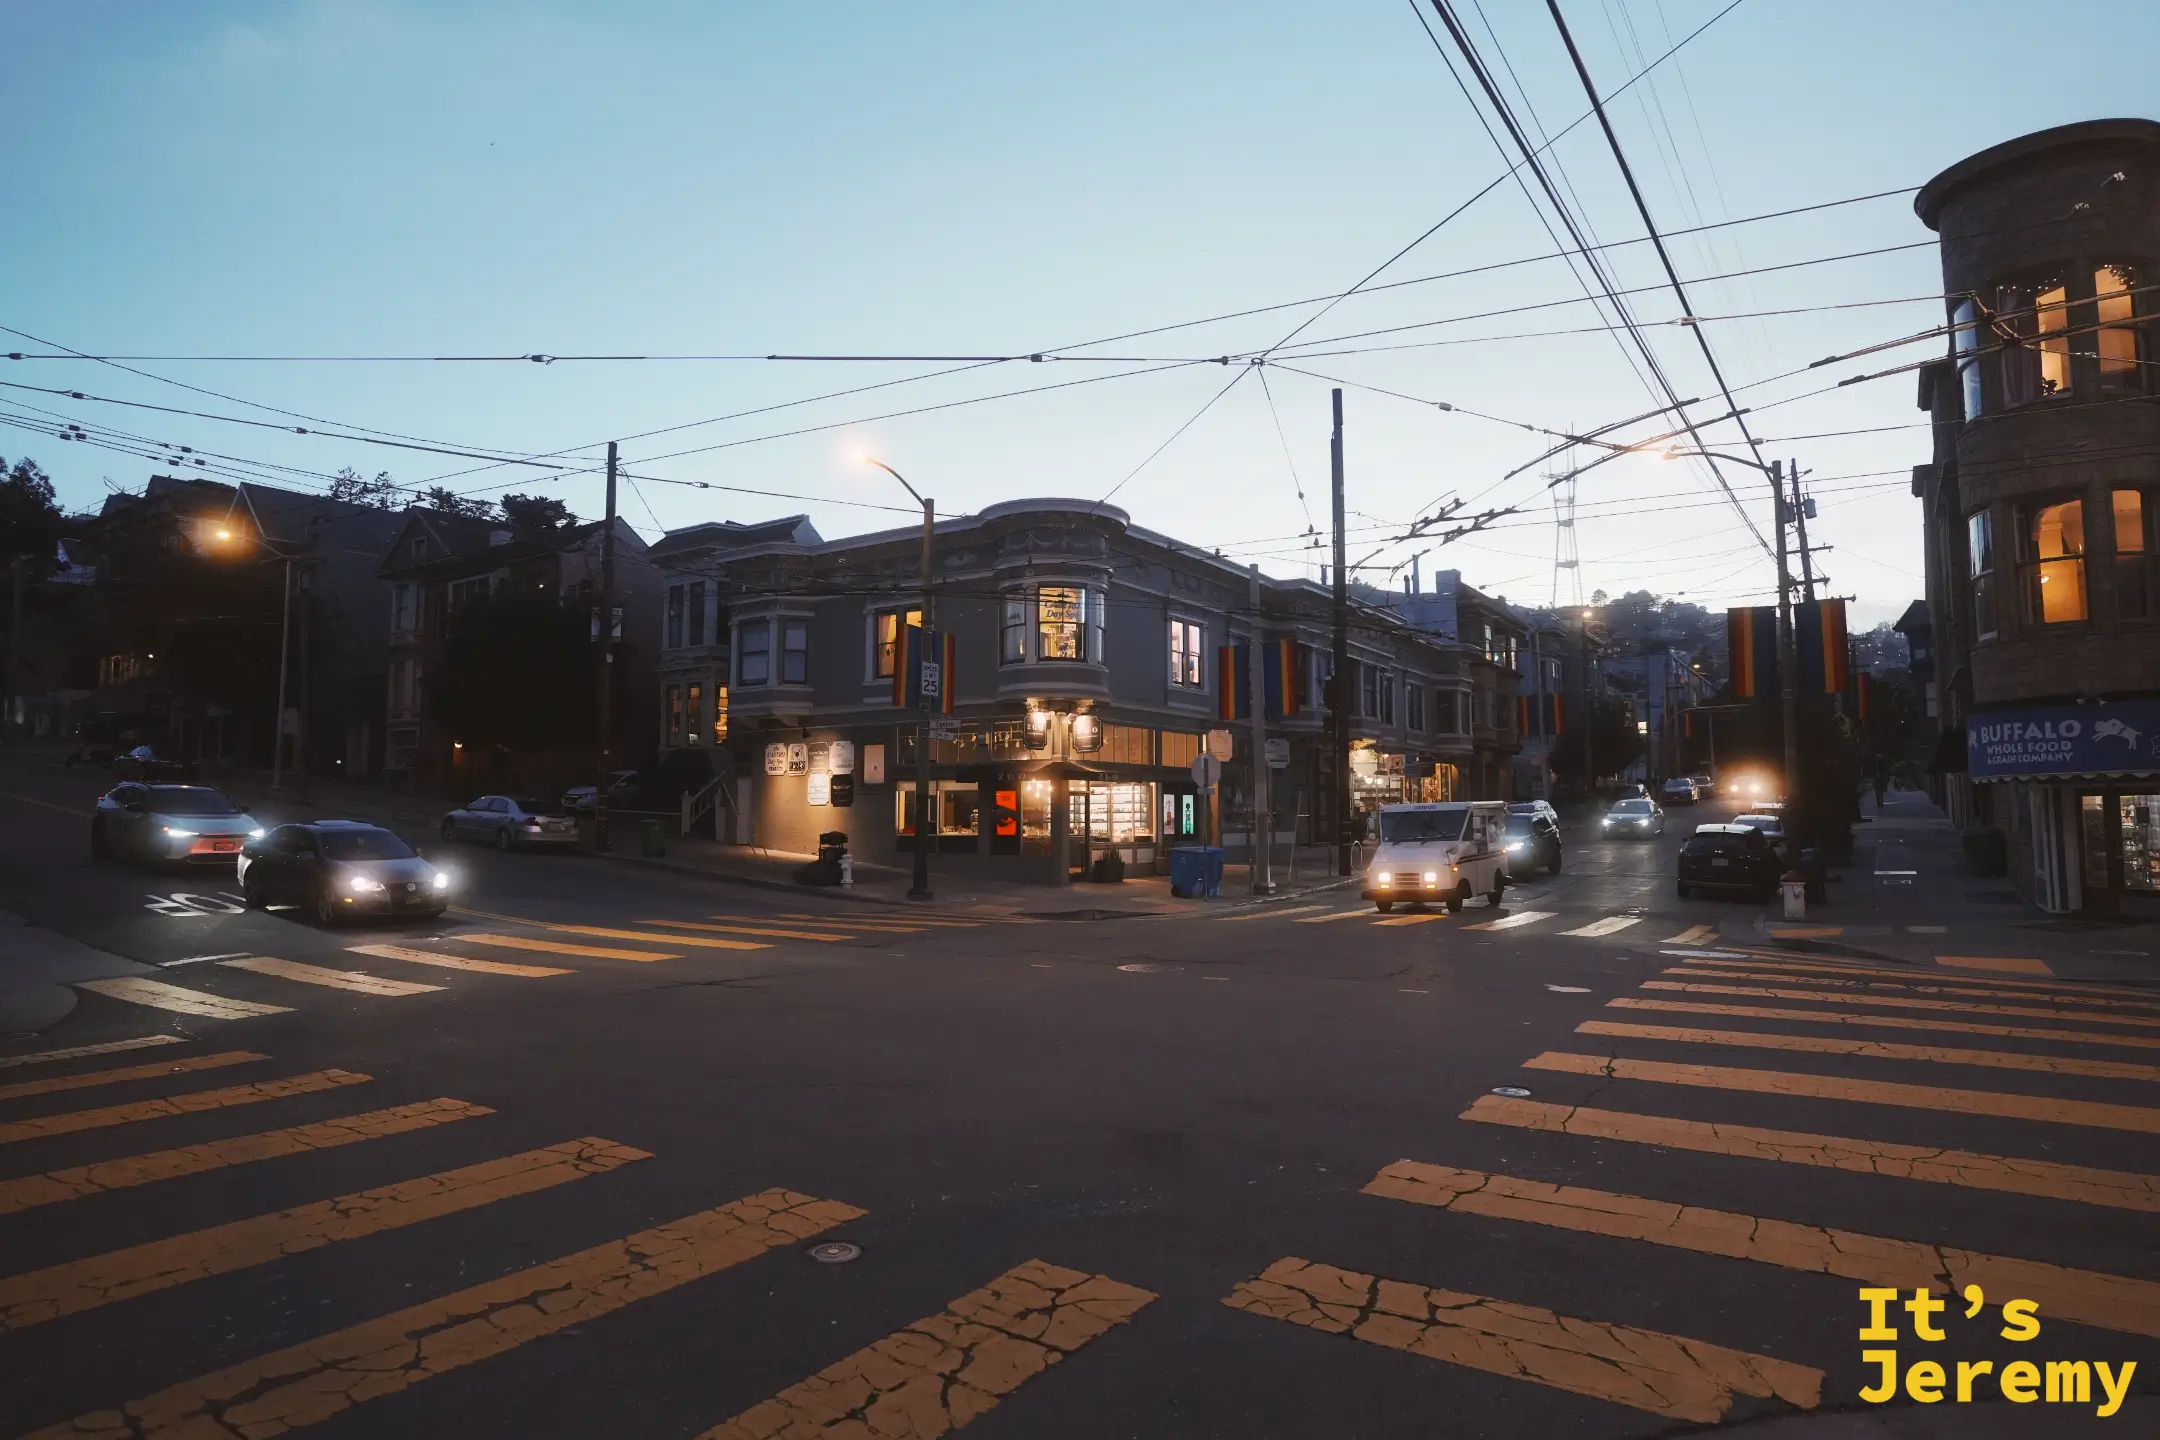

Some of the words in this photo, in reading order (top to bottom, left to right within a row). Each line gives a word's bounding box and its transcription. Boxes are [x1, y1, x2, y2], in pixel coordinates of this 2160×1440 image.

[923, 664, 938, 672] SPEED
[923, 680, 938, 693] 25
[1981, 719, 2082, 744] BUFFALO
[1986, 742, 2024, 755] WHOLE
[2027, 740, 2073, 753] FOOD
[2018, 752, 2074, 763] COMPANY
